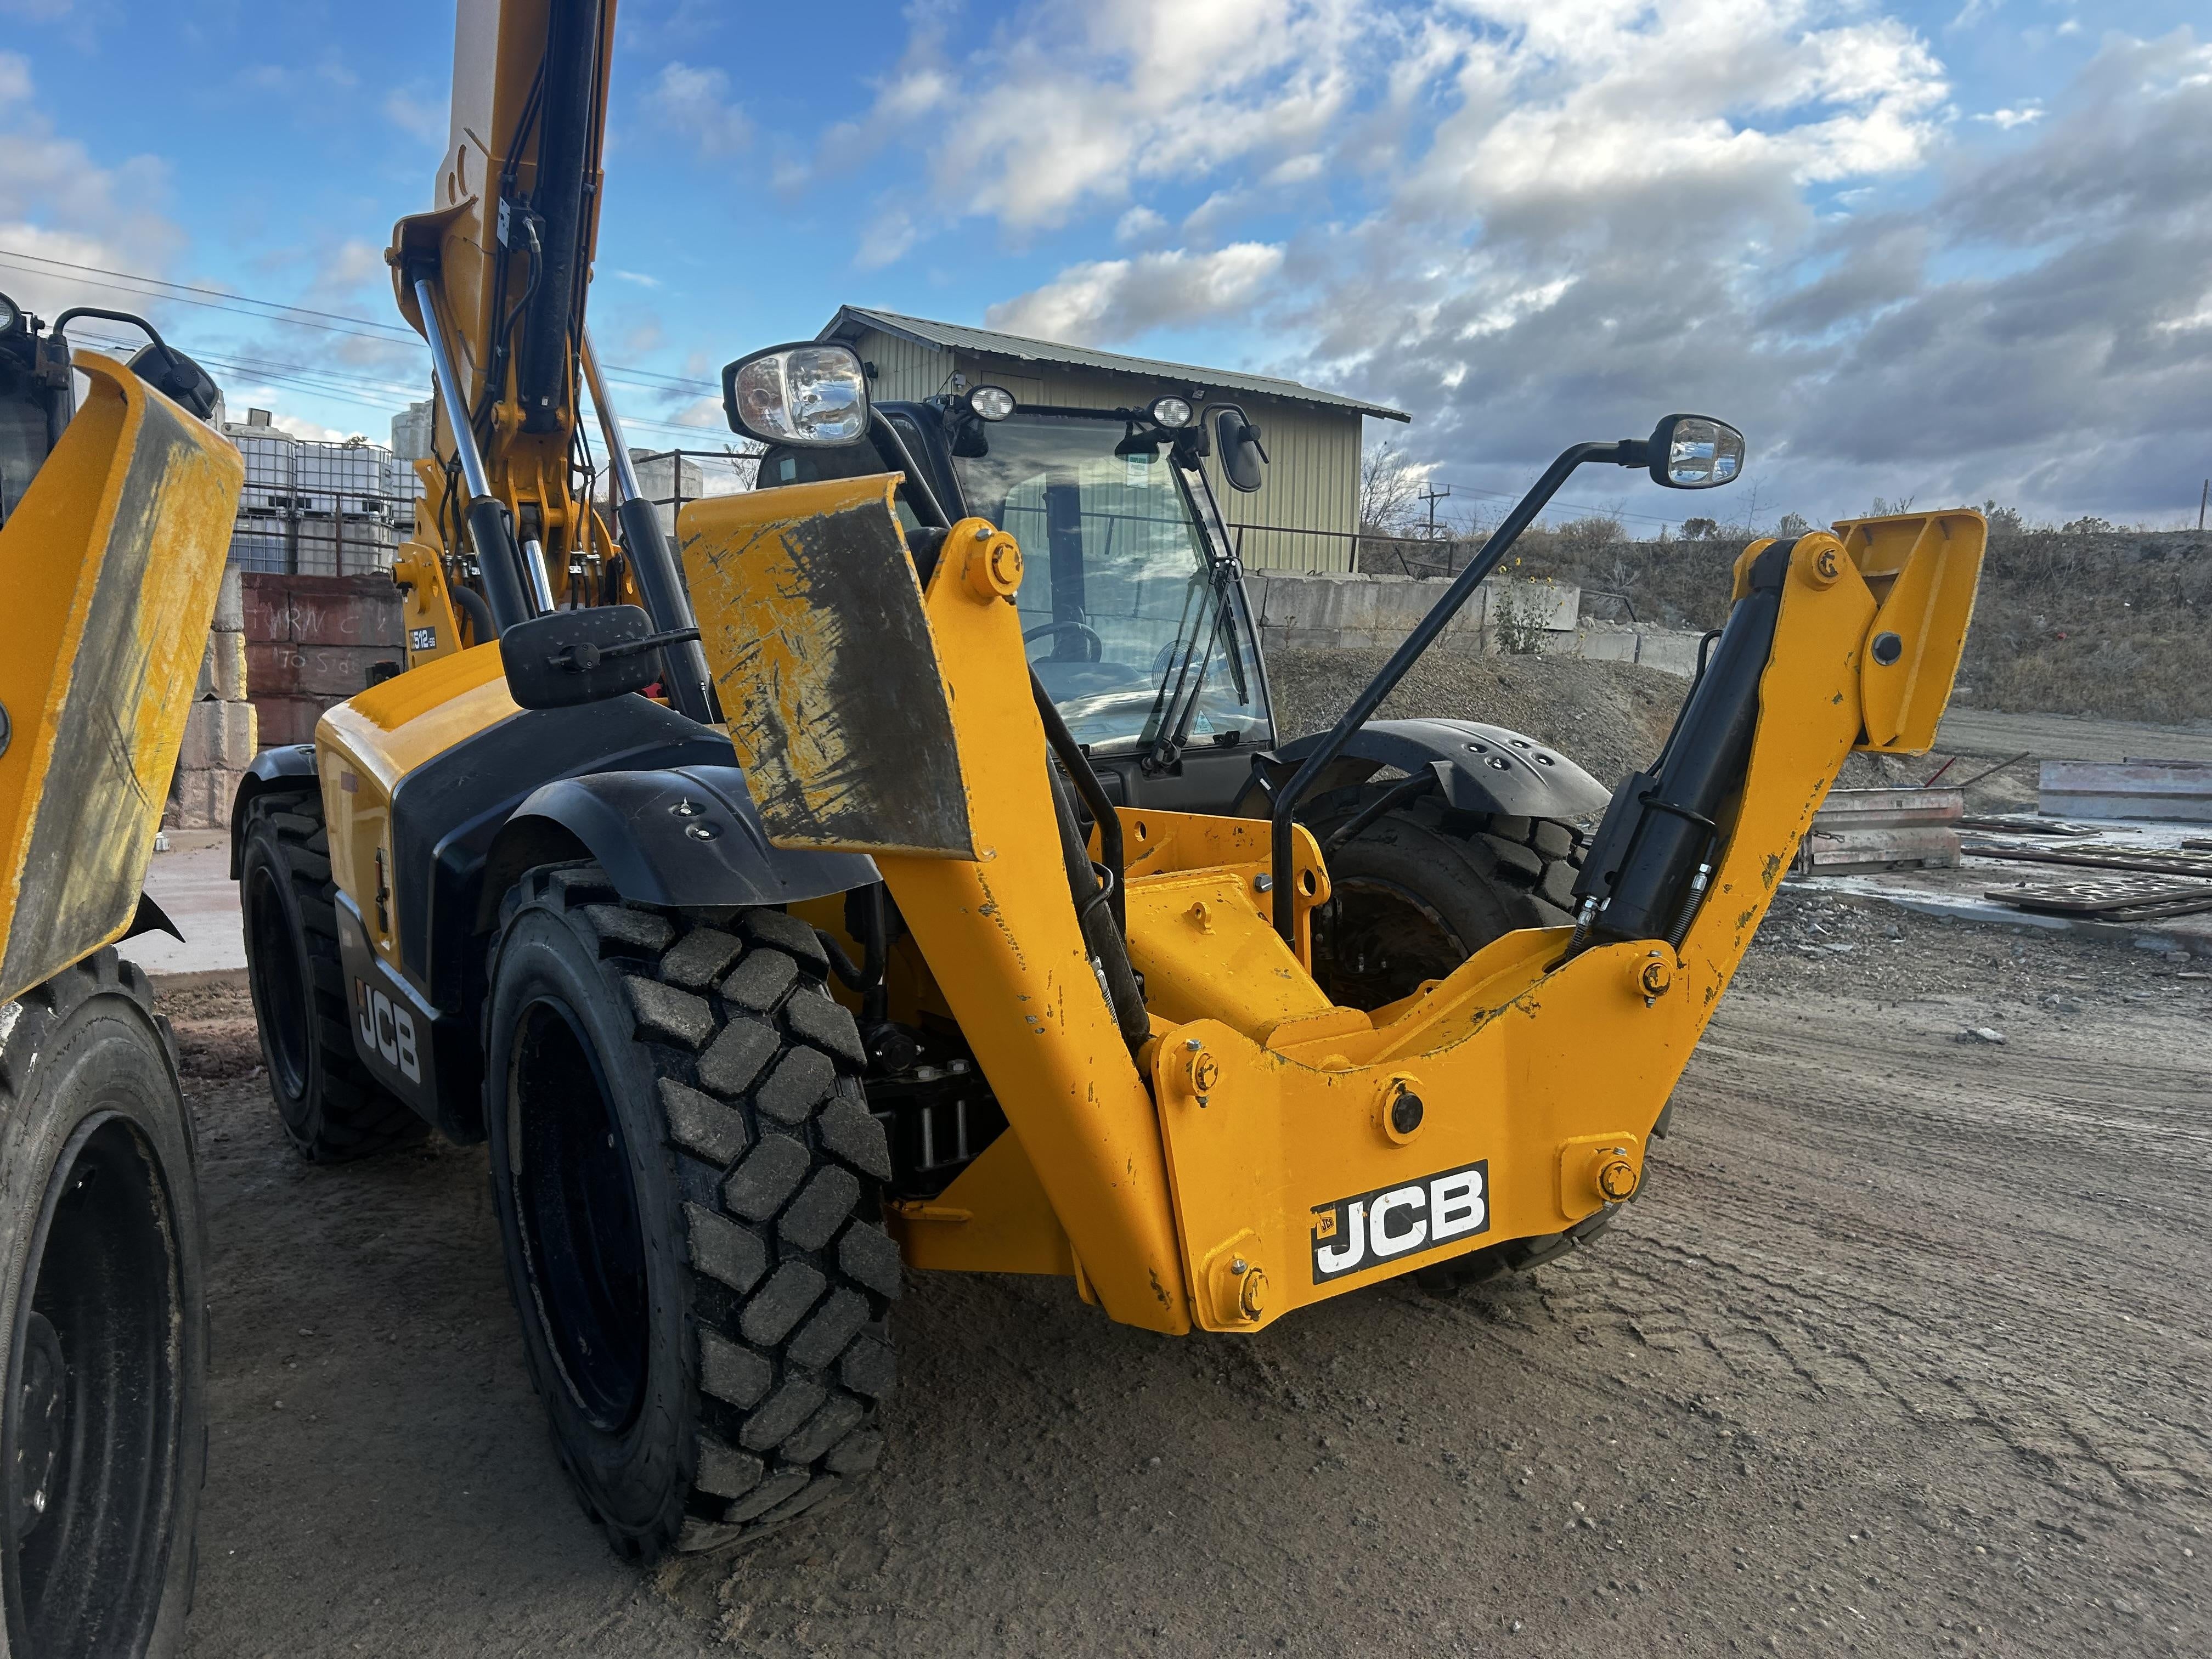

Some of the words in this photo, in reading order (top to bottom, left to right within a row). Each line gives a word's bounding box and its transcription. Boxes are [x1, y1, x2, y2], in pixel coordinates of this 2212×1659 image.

[360, 984, 421, 1084] JCB
[1317, 1170, 1485, 1273] JCB
[1322, 1218, 1333, 1231] JCB
